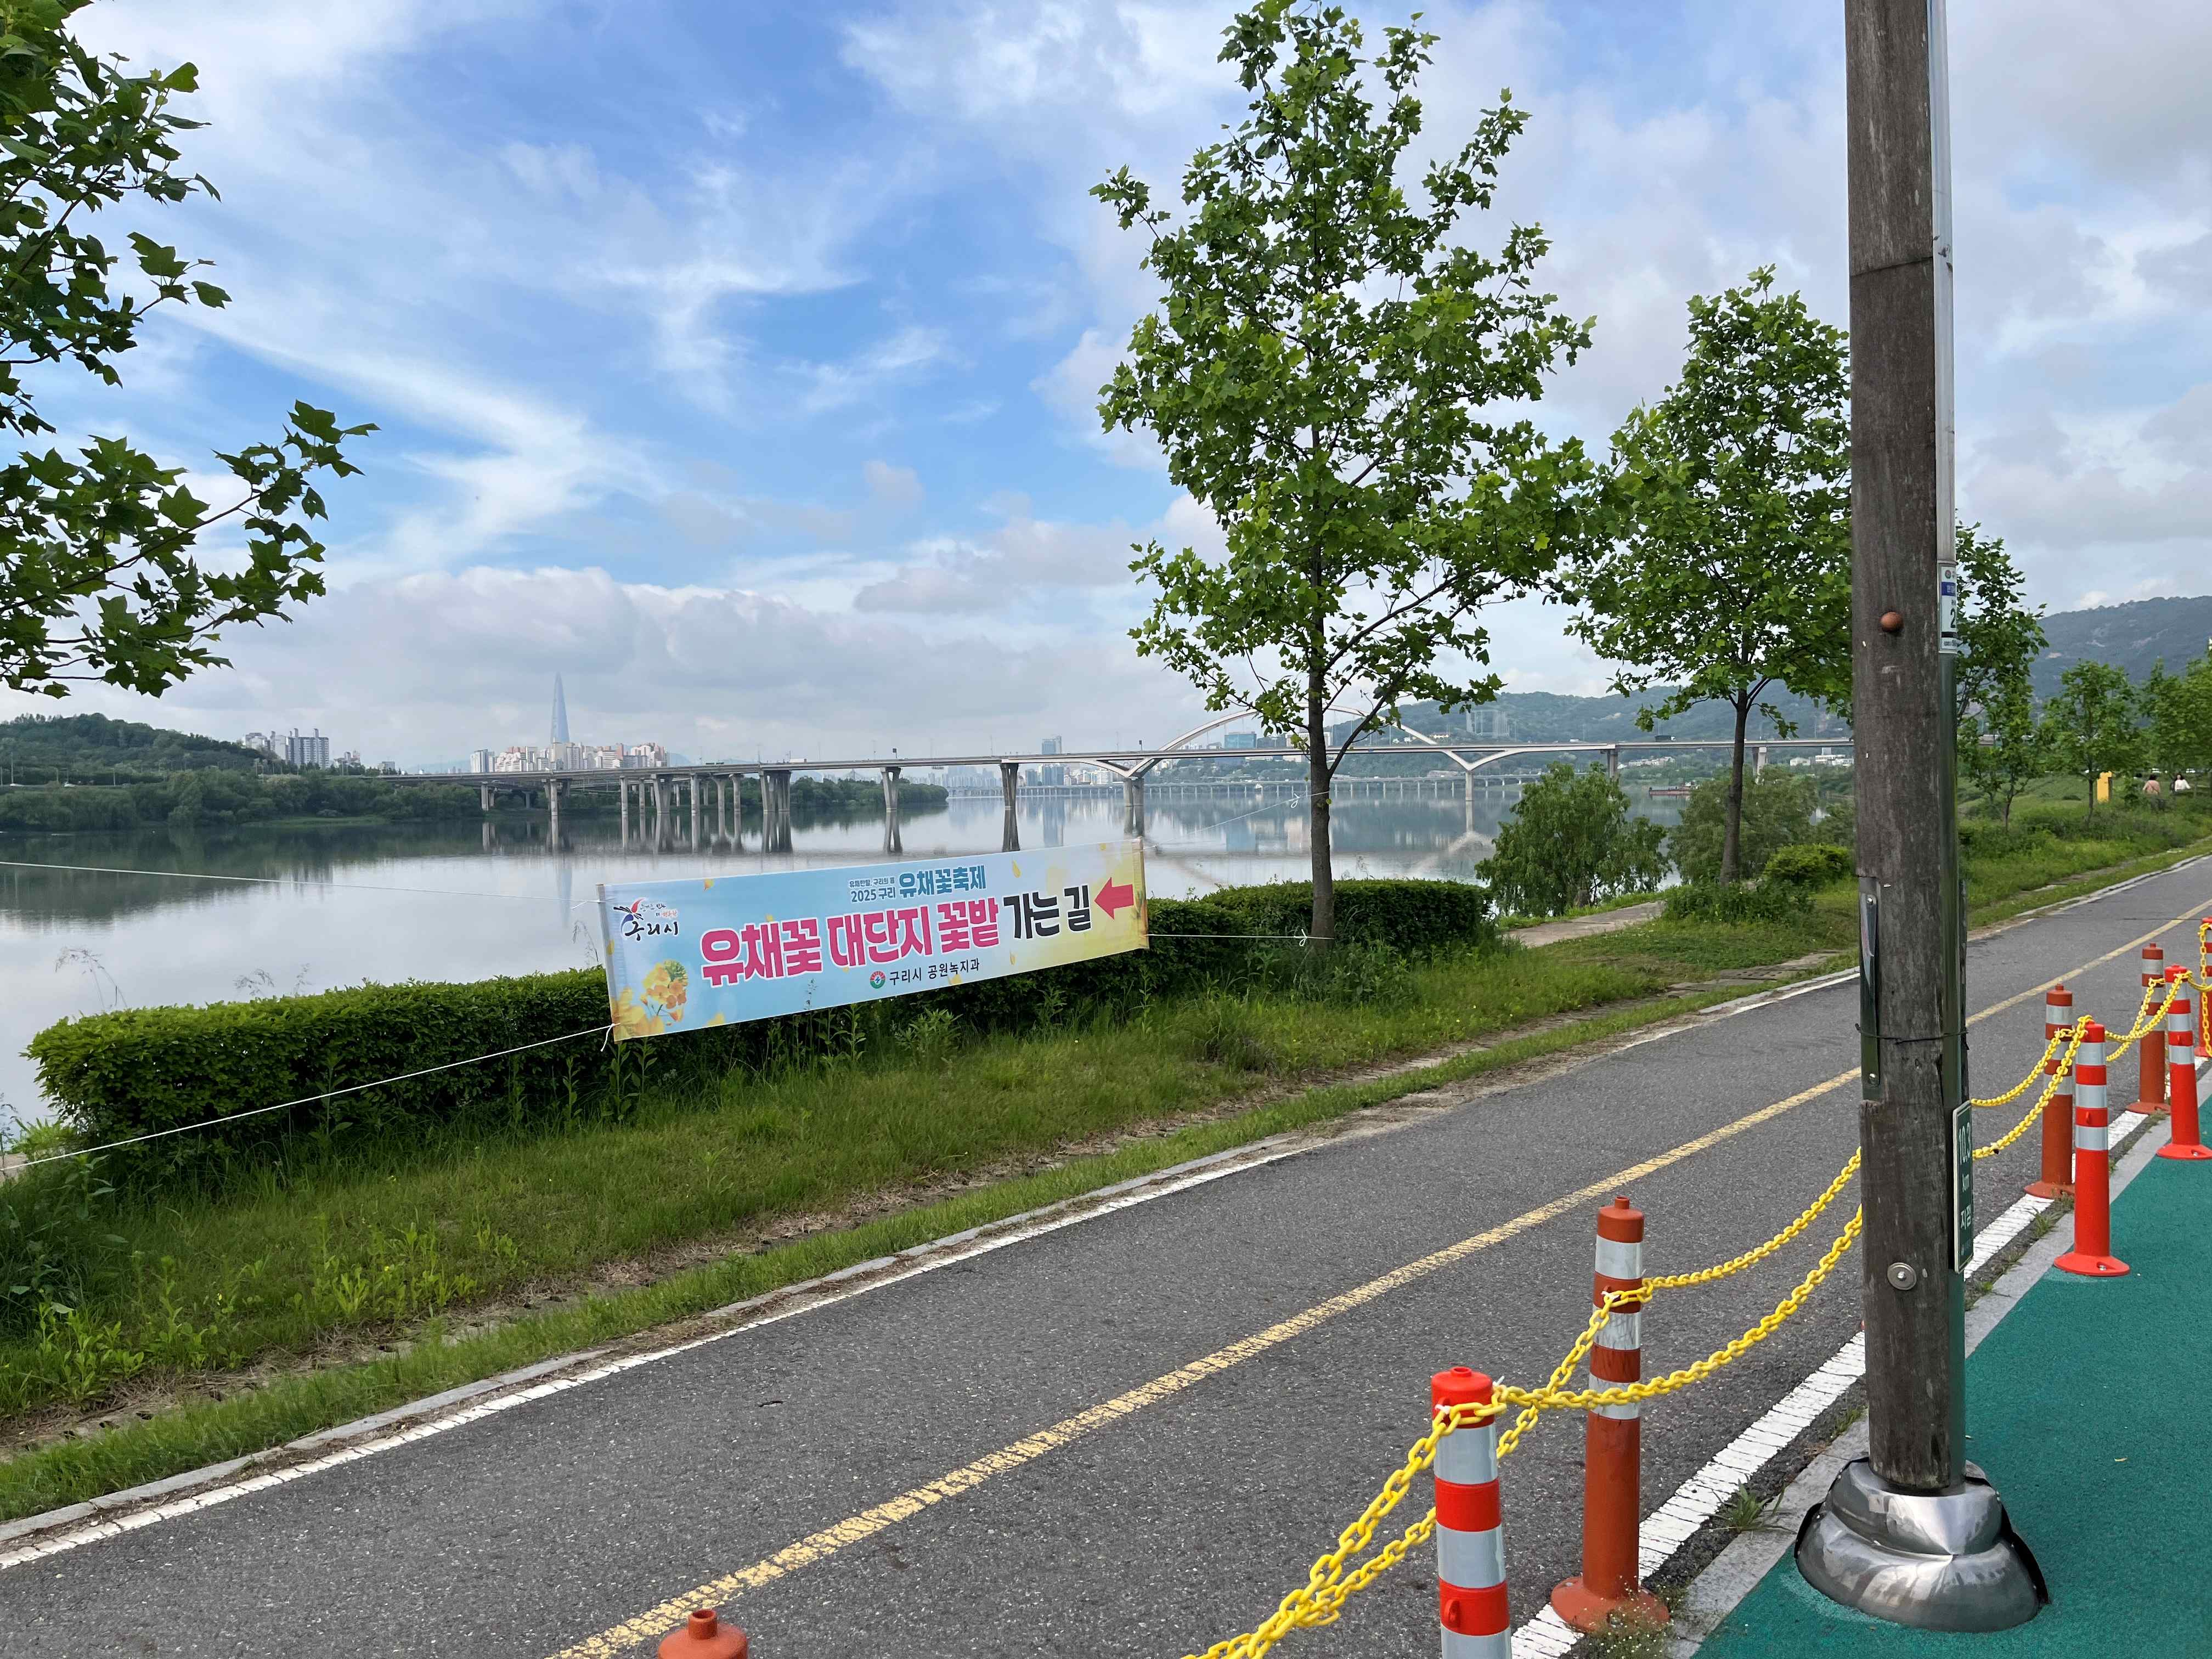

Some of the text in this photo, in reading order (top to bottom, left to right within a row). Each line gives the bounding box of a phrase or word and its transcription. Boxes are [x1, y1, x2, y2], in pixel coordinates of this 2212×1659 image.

[851, 865, 986, 902] 2025 구리 유채꽃축제
[625, 921, 678, 941] 구리시
[702, 885, 1091, 986] 유채꽃 대단지 꽃밭 가는 길
[889, 958, 980, 986] 구리시 공원녹지과
[1961, 1204, 1971, 1230] 지점
